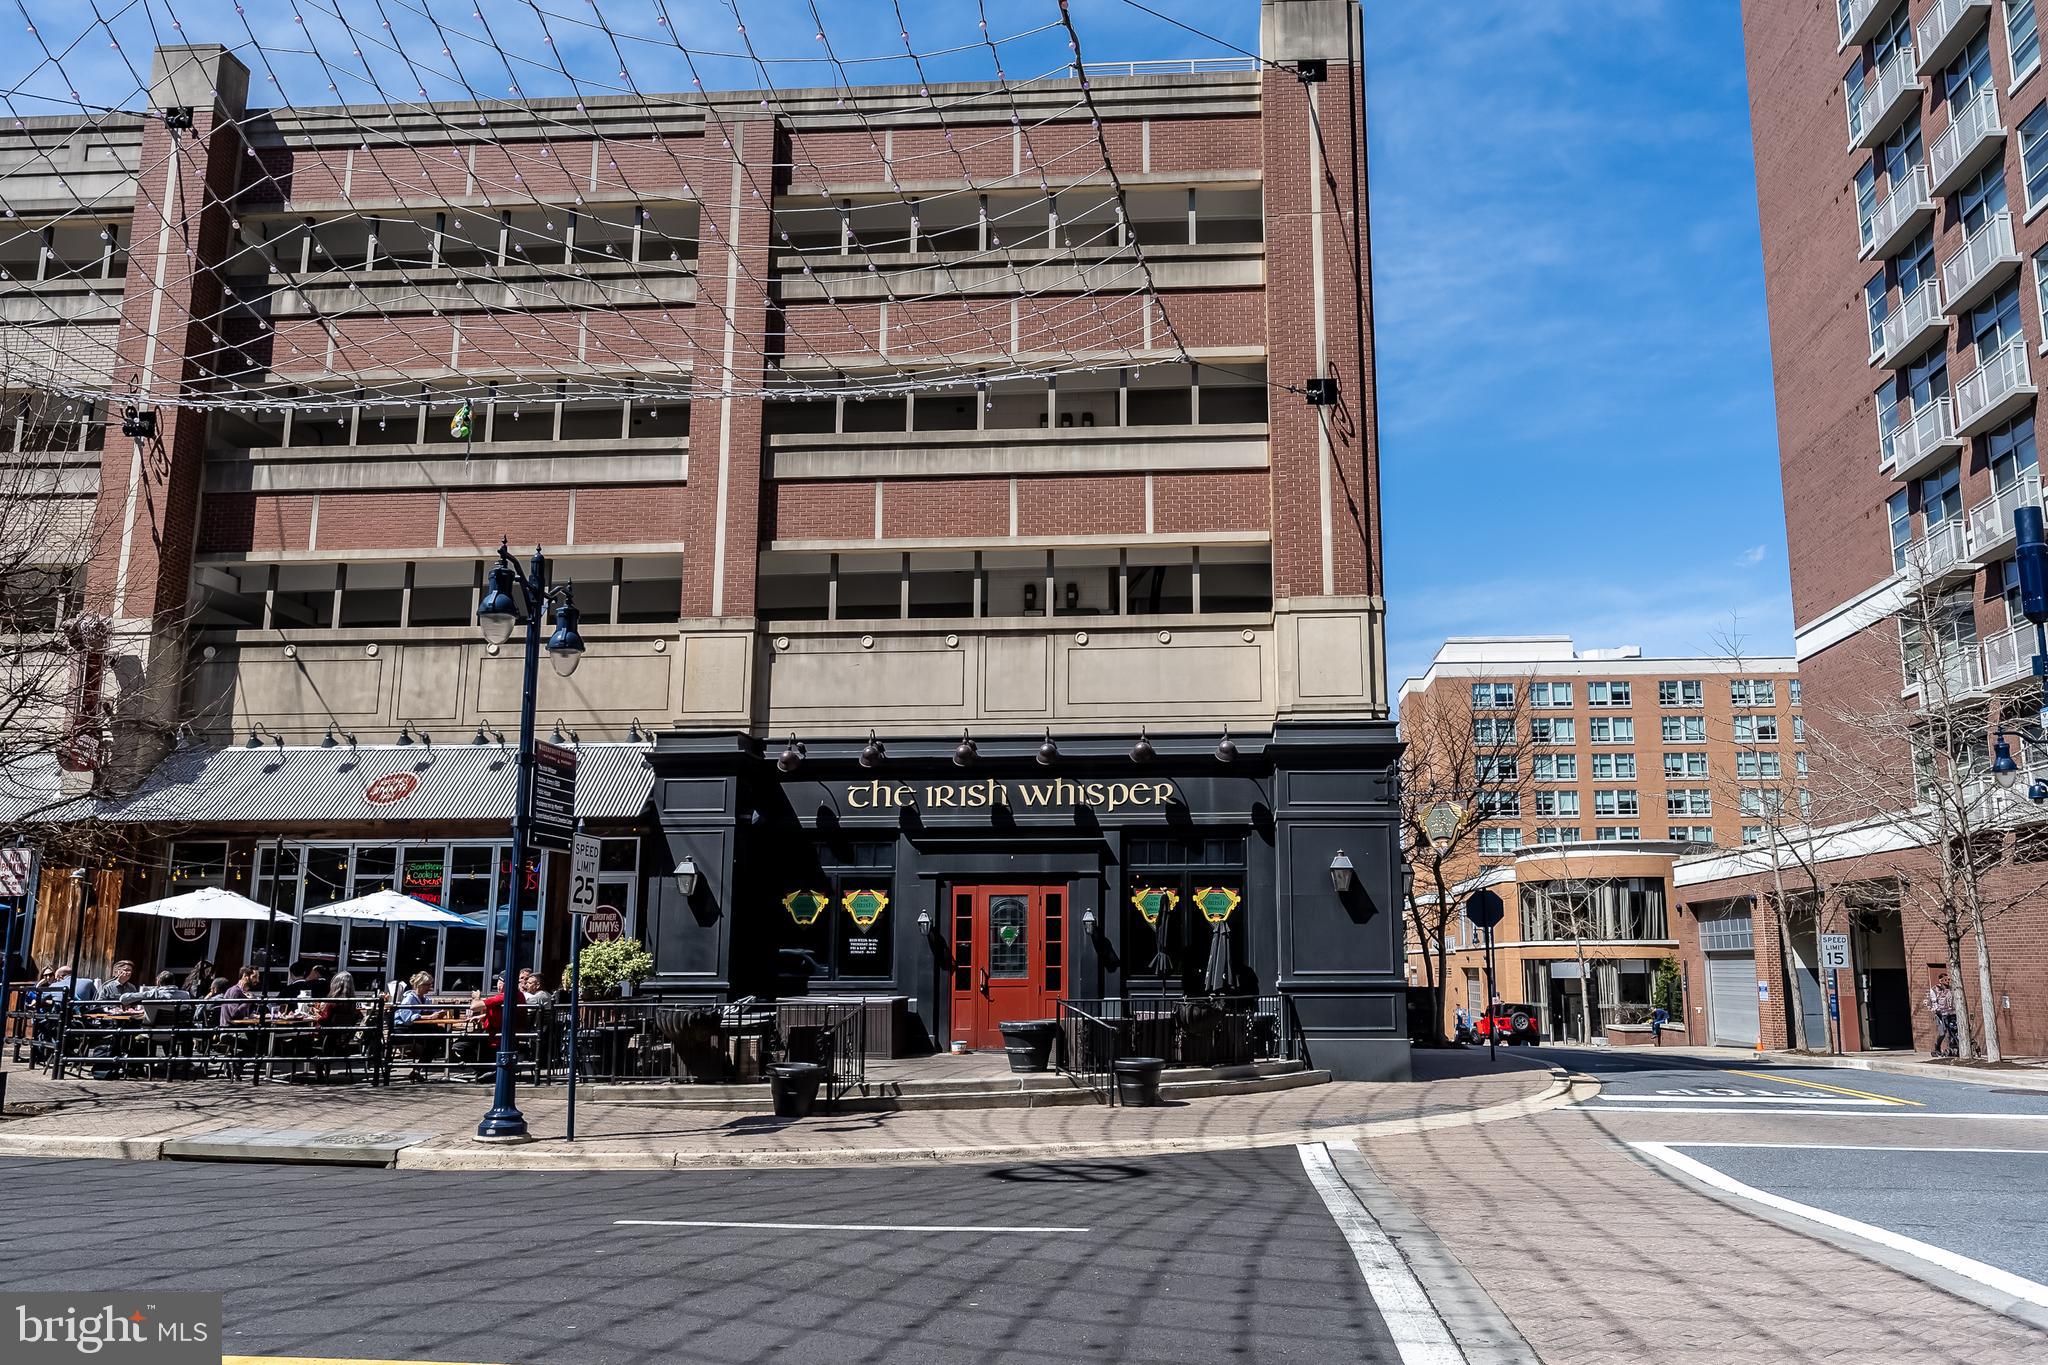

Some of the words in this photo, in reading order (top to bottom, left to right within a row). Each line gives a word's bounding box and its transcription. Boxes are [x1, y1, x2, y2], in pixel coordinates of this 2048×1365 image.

[10, 852, 20, 861] NO
[576, 843, 598, 858] SPEED
[2, 863, 26, 871] PARKING
[577, 861, 595, 873] LIMIT
[573, 875, 594, 905] 25
[1827, 952, 1844, 965] 15
[1656, 1088, 1837, 1097] STOP
